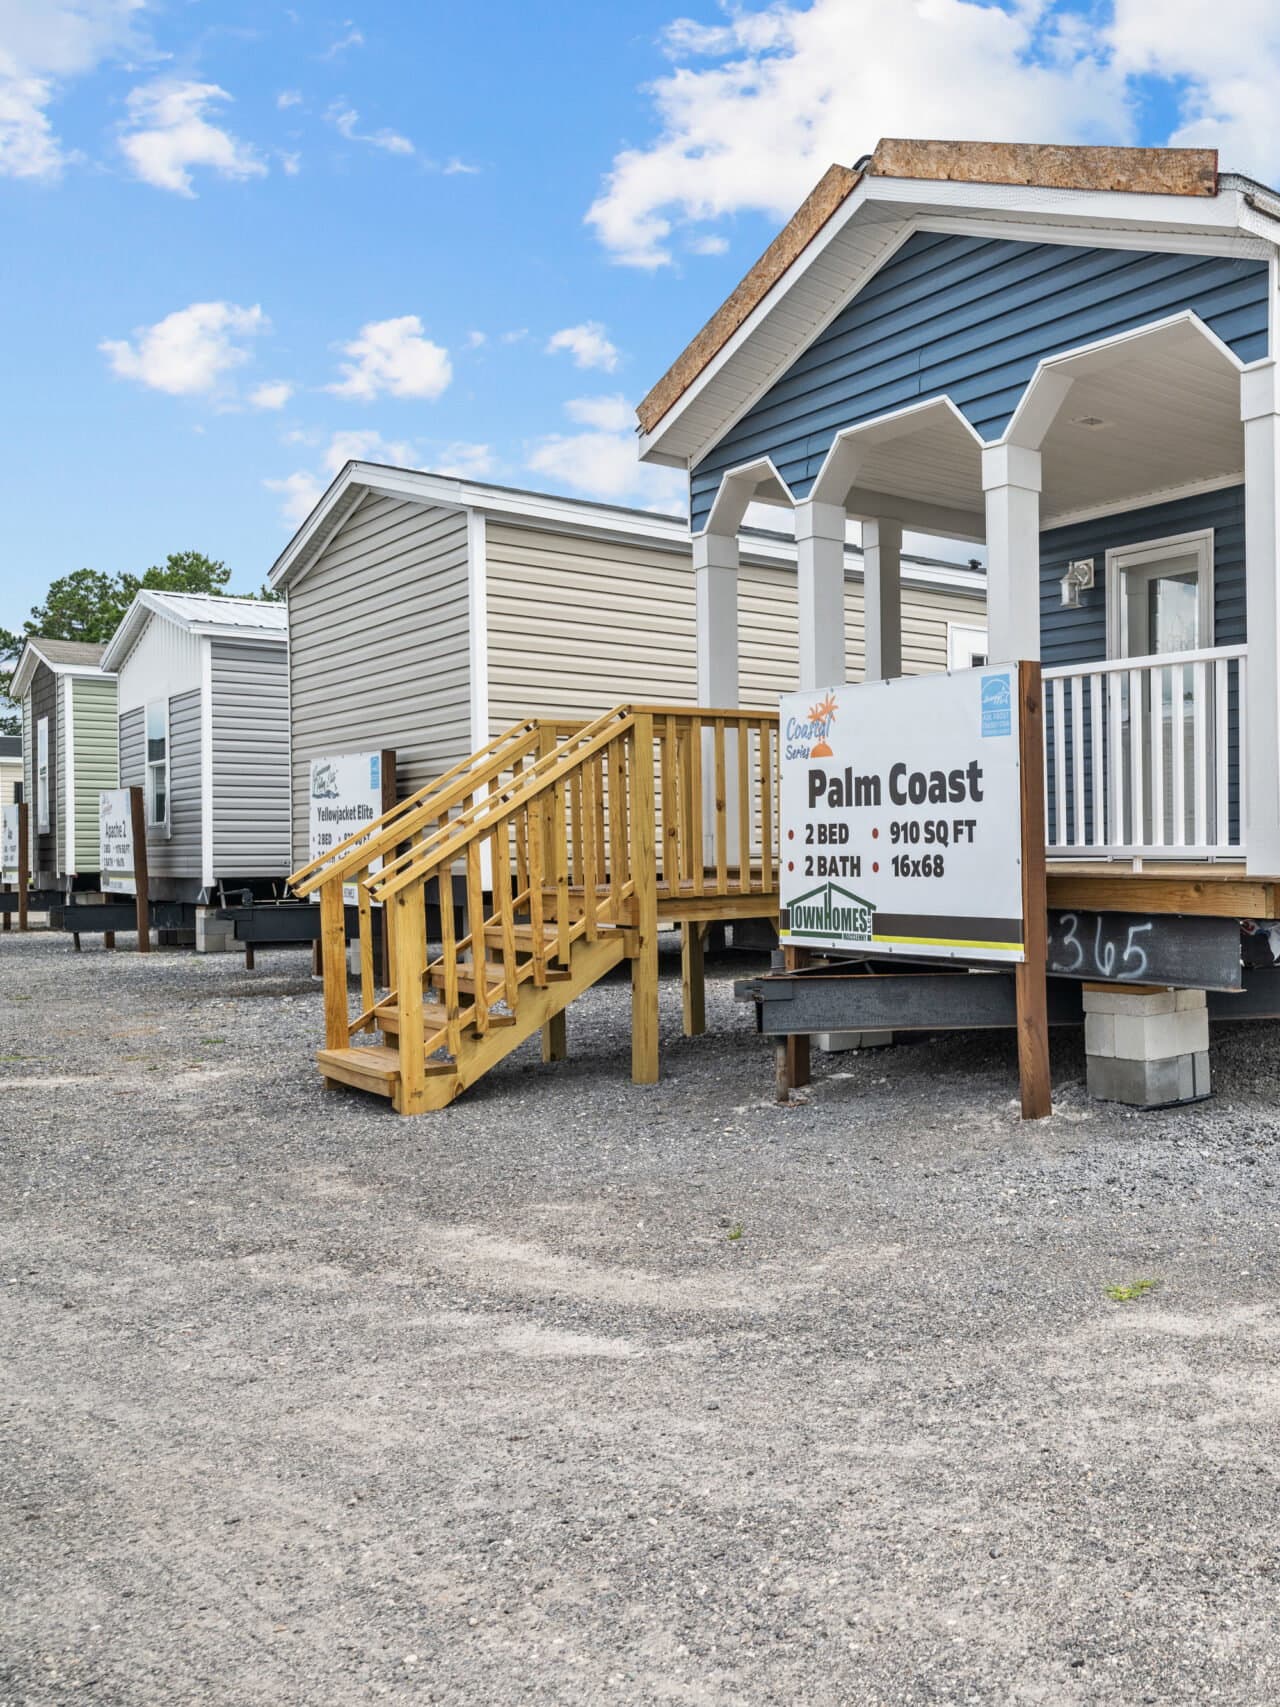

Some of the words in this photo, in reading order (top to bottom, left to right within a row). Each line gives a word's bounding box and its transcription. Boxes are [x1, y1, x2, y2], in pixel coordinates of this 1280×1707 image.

[786, 711, 833, 741] Coastal
[785, 744, 810, 761] Series
[808, 766, 882, 809] Palm
[889, 759, 984, 807] Coast
[317, 805, 356, 825] Yellowjacket
[357, 804, 374, 820] Elite
[805, 823, 814, 845] 2
[817, 823, 850, 845] BED
[890, 820, 921, 845] 910
[924, 820, 949, 849] SQ
[953, 819, 977, 844] FT
[804, 855, 814, 877] 2
[817, 855, 861, 877] BATH
[891, 854, 945, 878] 16x68
[789, 891, 869, 933] TOWNHOMES
